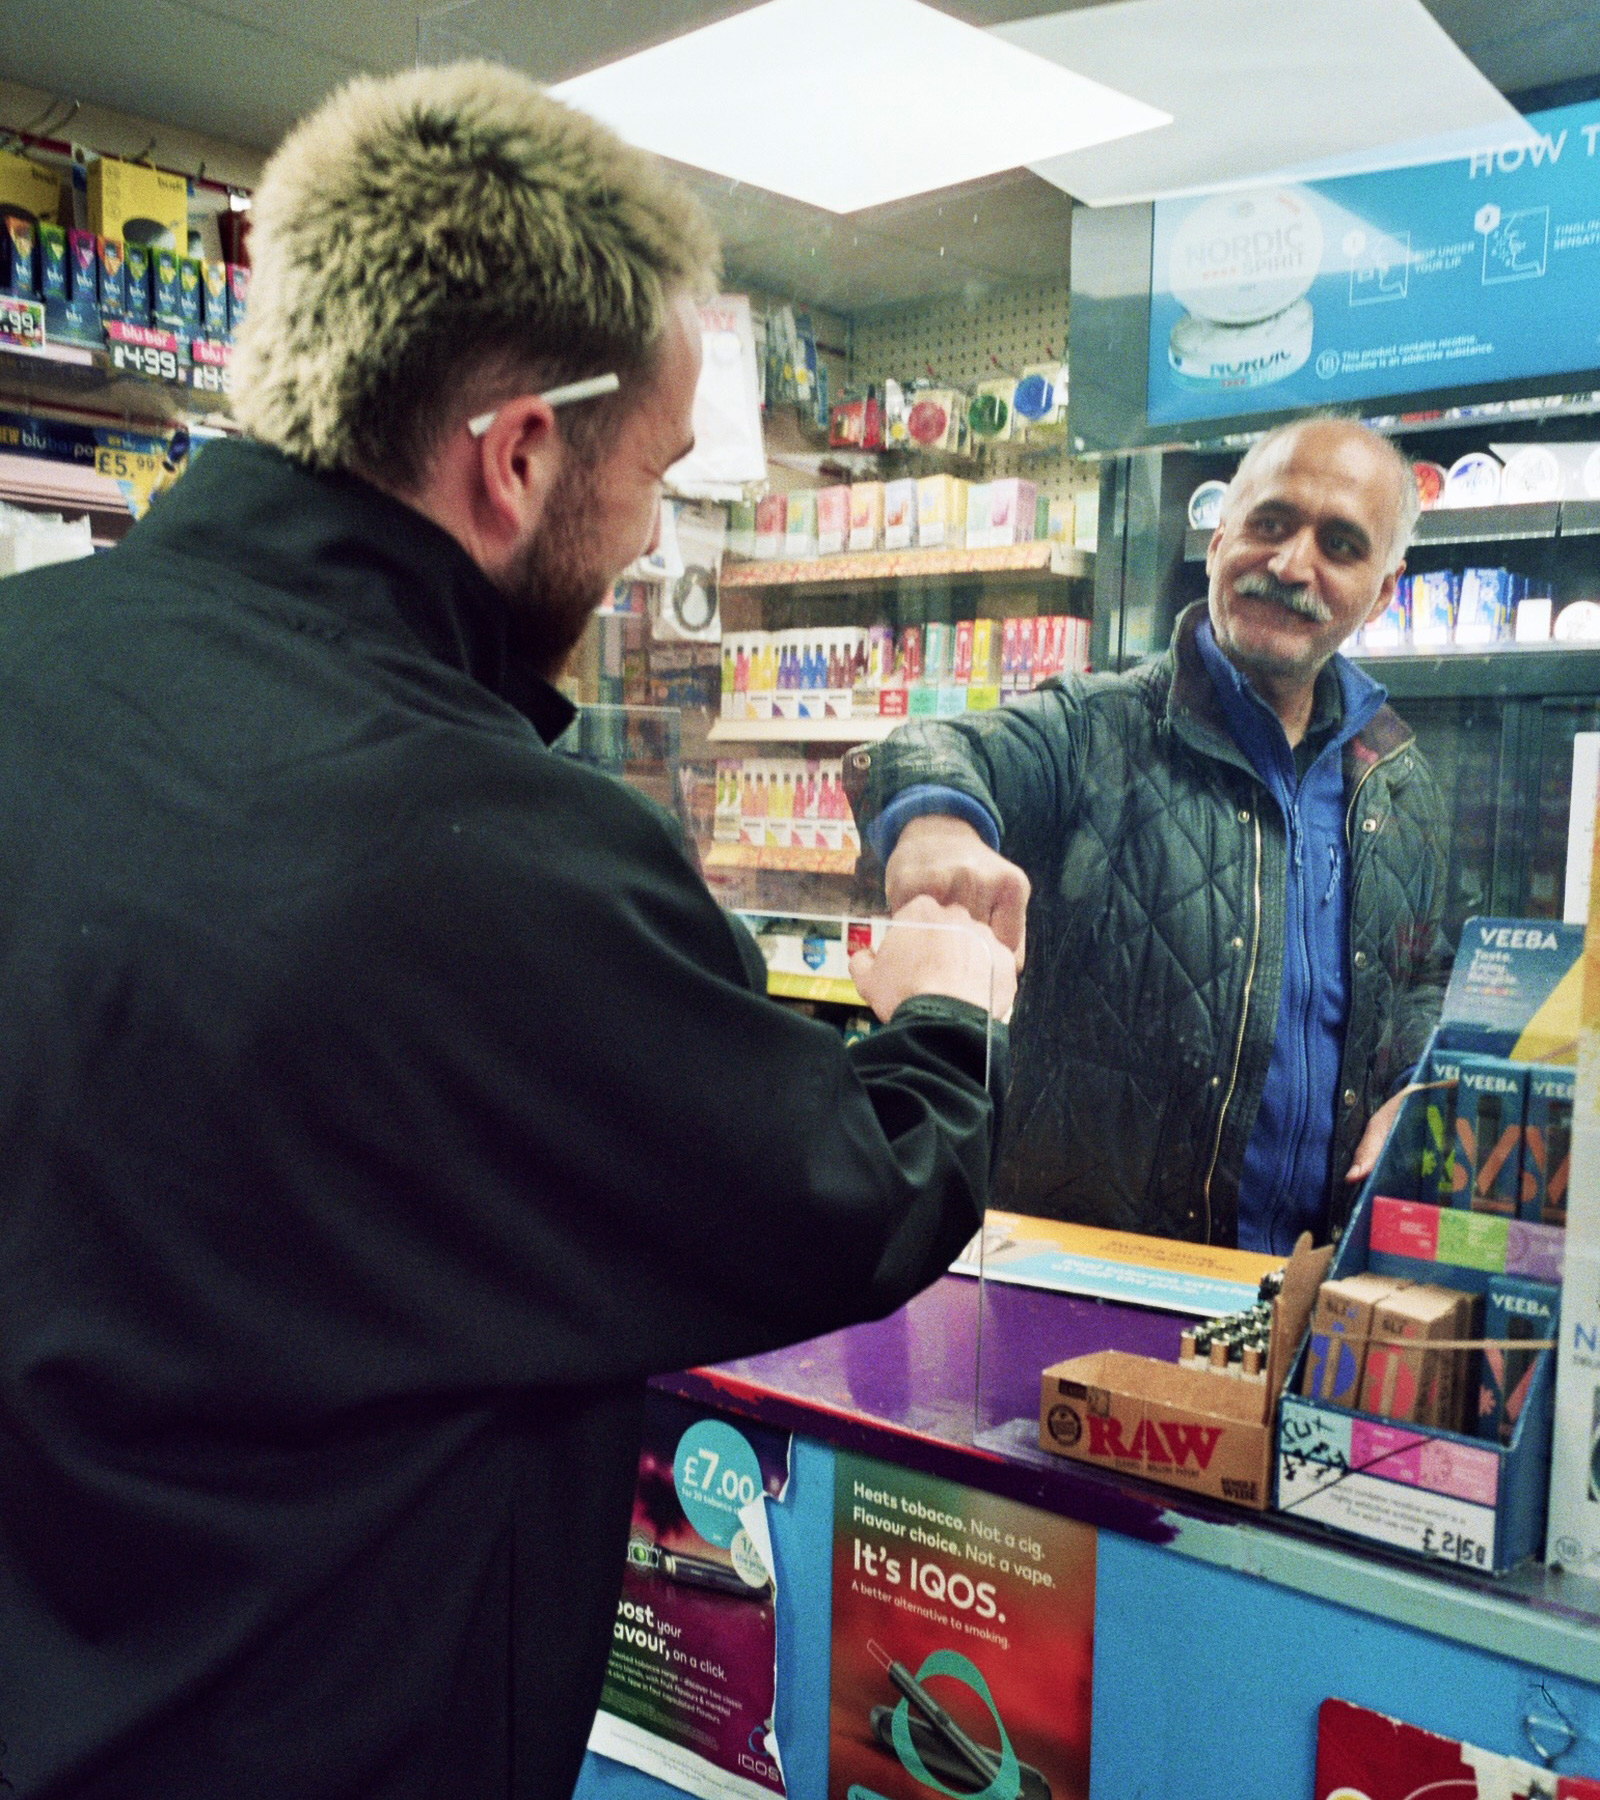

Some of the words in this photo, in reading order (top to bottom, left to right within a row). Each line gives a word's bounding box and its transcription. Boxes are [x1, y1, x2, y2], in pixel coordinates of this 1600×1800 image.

[1469, 129, 1568, 180] HOW
[1187, 223, 1303, 268] NORDIC
[0, 311, 35, 337] .99
[122, 322, 143, 341] blu
[144, 327, 167, 347] bar
[114, 345, 176, 379] £4.99
[1342, 351, 1360, 361] This
[1360, 345, 1397, 360] product
[1398, 340, 1437, 354] contains
[1401, 350, 1444, 365] addictive
[22, 432, 47, 450] blu
[74, 442, 96, 458] po
[1480, 926, 1559, 951] VEEBA
[1463, 1074, 1518, 1093] VEEBA
[1492, 1294, 1552, 1317] VEEBA
[1087, 1413, 1224, 1470] RAW
[684, 1449, 755, 1504] £7.00
[854, 1480, 897, 1510] Heats
[901, 1497, 967, 1533] tobacco.
[970, 1518, 1001, 1543] Not
[1005, 1533, 1015, 1548] a
[1018, 1537, 1046, 1562] cig.
[853, 1506, 906, 1537] Flavour
[909, 1526, 961, 1557] choice.
[965, 1542, 996, 1567] Not
[999, 1556, 1010, 1572] a
[1014, 1562, 1056, 1589] vape.
[853, 1538, 901, 1584] It's
[910, 1558, 1006, 1623] IQOS.
[657, 1619, 682, 1639] your
[851, 1580, 859, 1592] A
[860, 1583, 892, 1604] better
[894, 1596, 949, 1626] alternative
[950, 1617, 962, 1630] to
[964, 1621, 1011, 1650] smoking.
[613, 1621, 670, 1661] avour,
[673, 1649, 687, 1664] on
[690, 1657, 697, 1669] a
[700, 1661, 728, 1683] click.
[737, 1752, 780, 1782] IQOS
